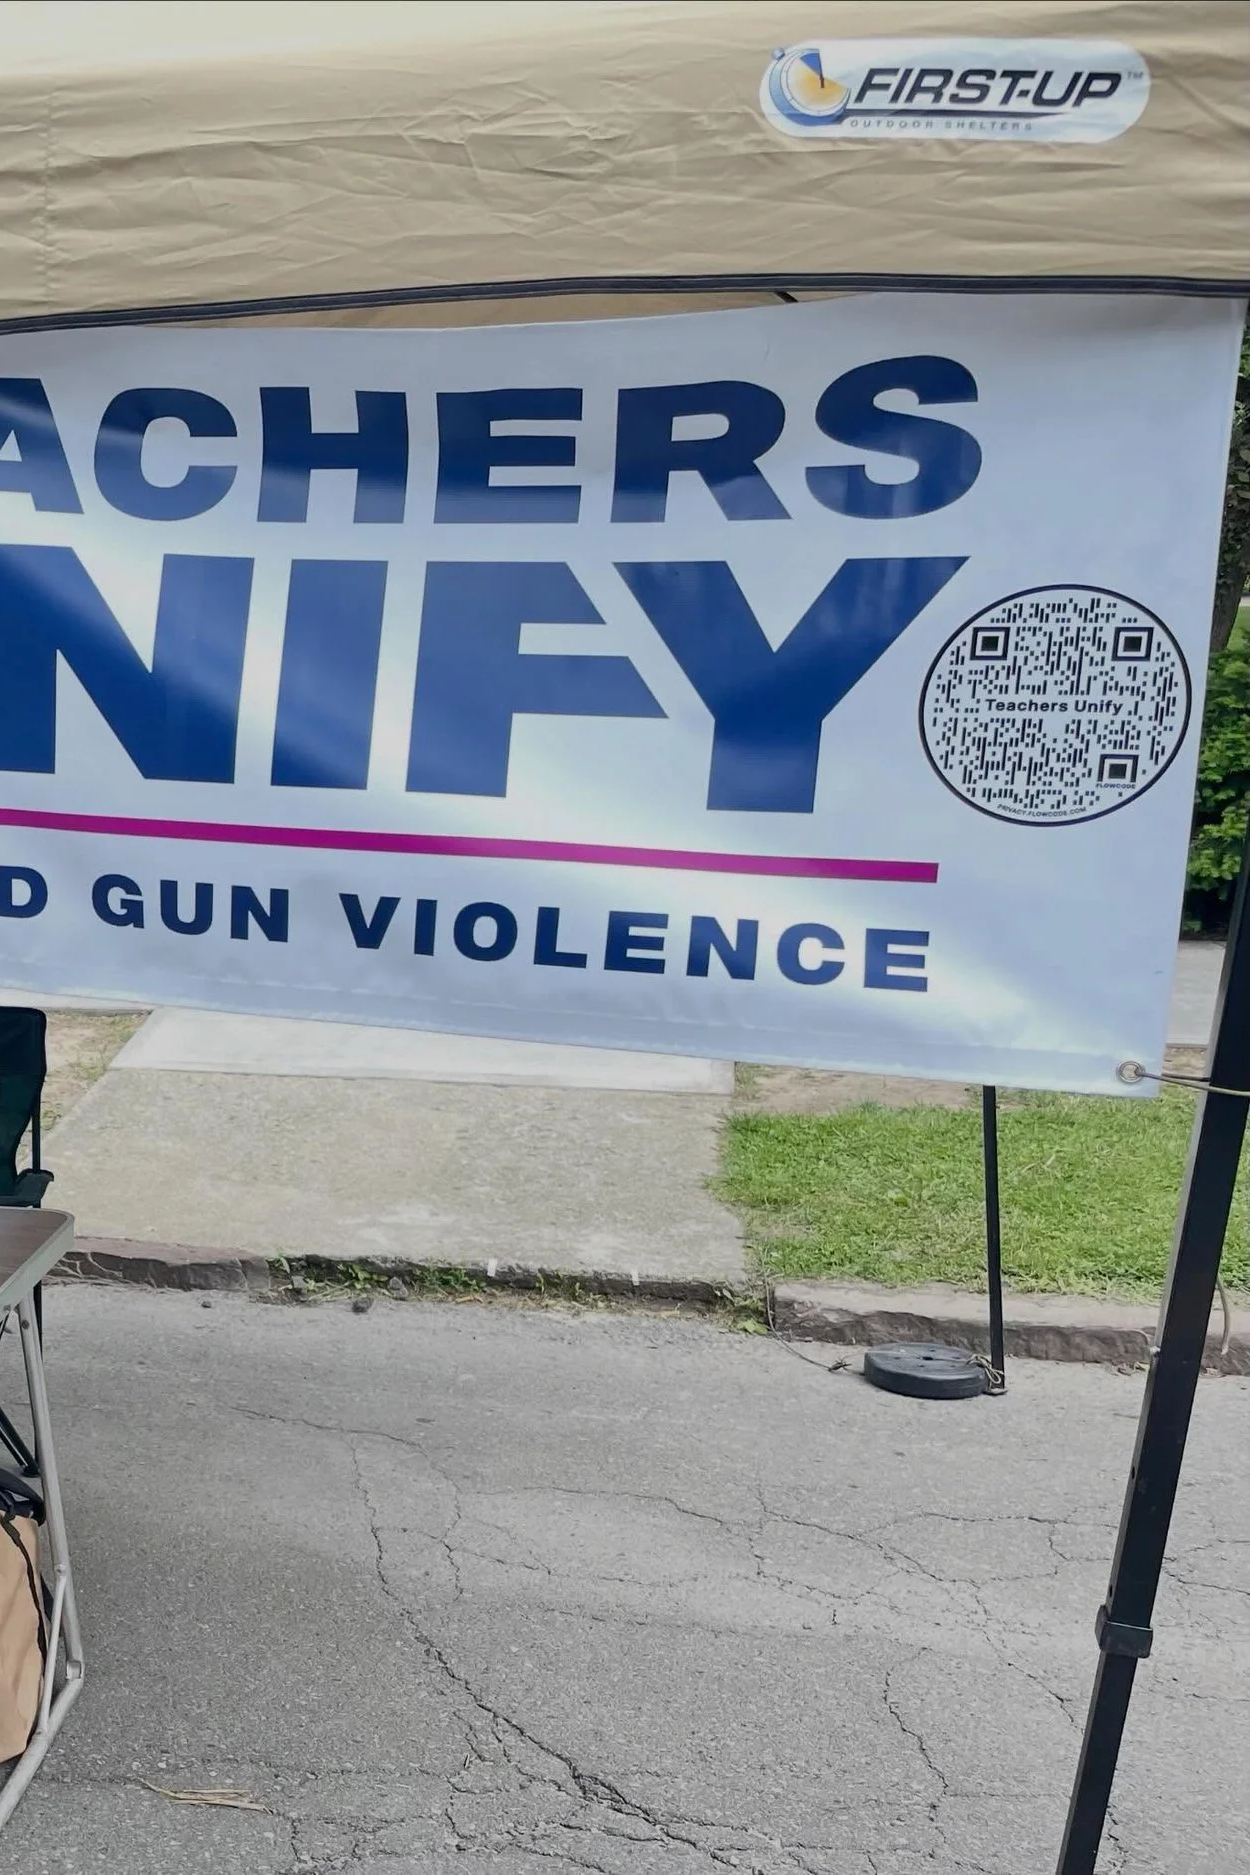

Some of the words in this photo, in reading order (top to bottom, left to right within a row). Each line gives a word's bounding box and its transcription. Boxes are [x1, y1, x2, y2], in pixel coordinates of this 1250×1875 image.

[853, 67, 1122, 108] FIRST-UP
[849, 118, 934, 130] OUTDOOR
[944, 119, 1032, 132] SHELTERS
[984, 698, 1069, 712] Teachers
[1074, 699, 1124, 717] Unify
[1095, 782, 1137, 790] FLOWCODE
[996, 803, 1087, 818] PRIVACY.FLOWCODE.COM
[91, 873, 289, 943] GUN
[338, 893, 931, 993] VIOLENCE
